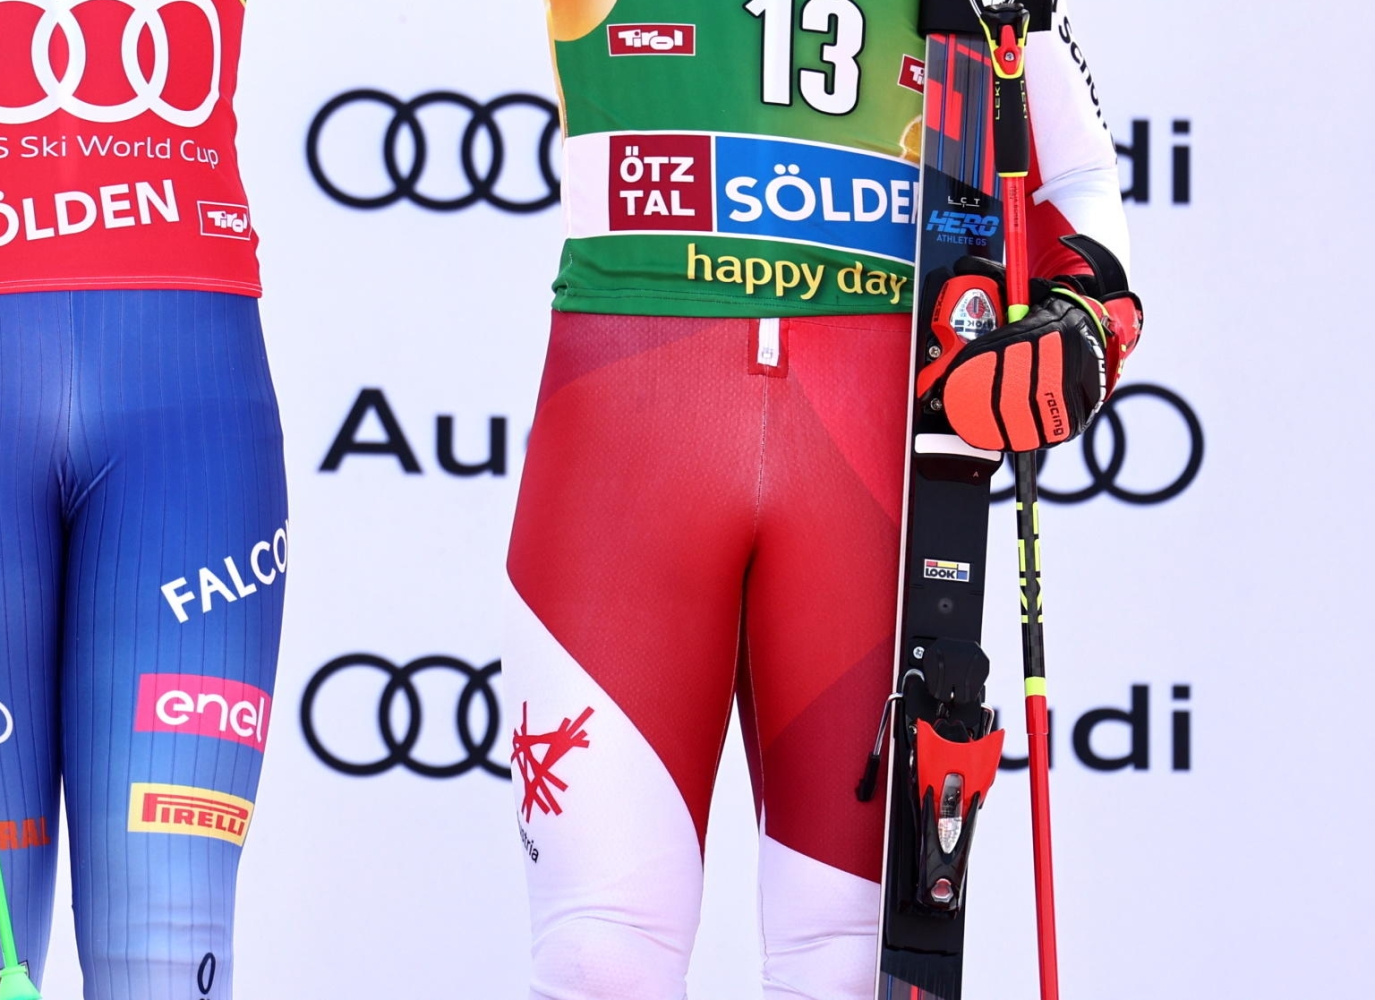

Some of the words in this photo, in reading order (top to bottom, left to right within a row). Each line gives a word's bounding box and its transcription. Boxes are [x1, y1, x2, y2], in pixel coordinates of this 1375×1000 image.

[618, 28, 684, 51] Tirol
[21, 135, 67, 158] Ski
[76, 134, 172, 160] World
[180, 139, 219, 170] Cup
[620, 146, 694, 183] ÖTZ
[207, 209, 248, 233] Tirol
[620, 190, 695, 217] TAL
[925, 209, 1000, 237] HERO
[936, 234, 972, 246] ATHLETE
[973, 237, 987, 247] GS
[686, 243, 825, 298] happy
[836, 260, 907, 303] day
[1045, 391, 1064, 436] racing
[318, 387, 509, 477] Au
[160, 518, 288, 624] FALCO
[925, 567, 956, 578] LOOK
[155, 689, 264, 745] enel
[142, 793, 250, 837] PIRELLI
